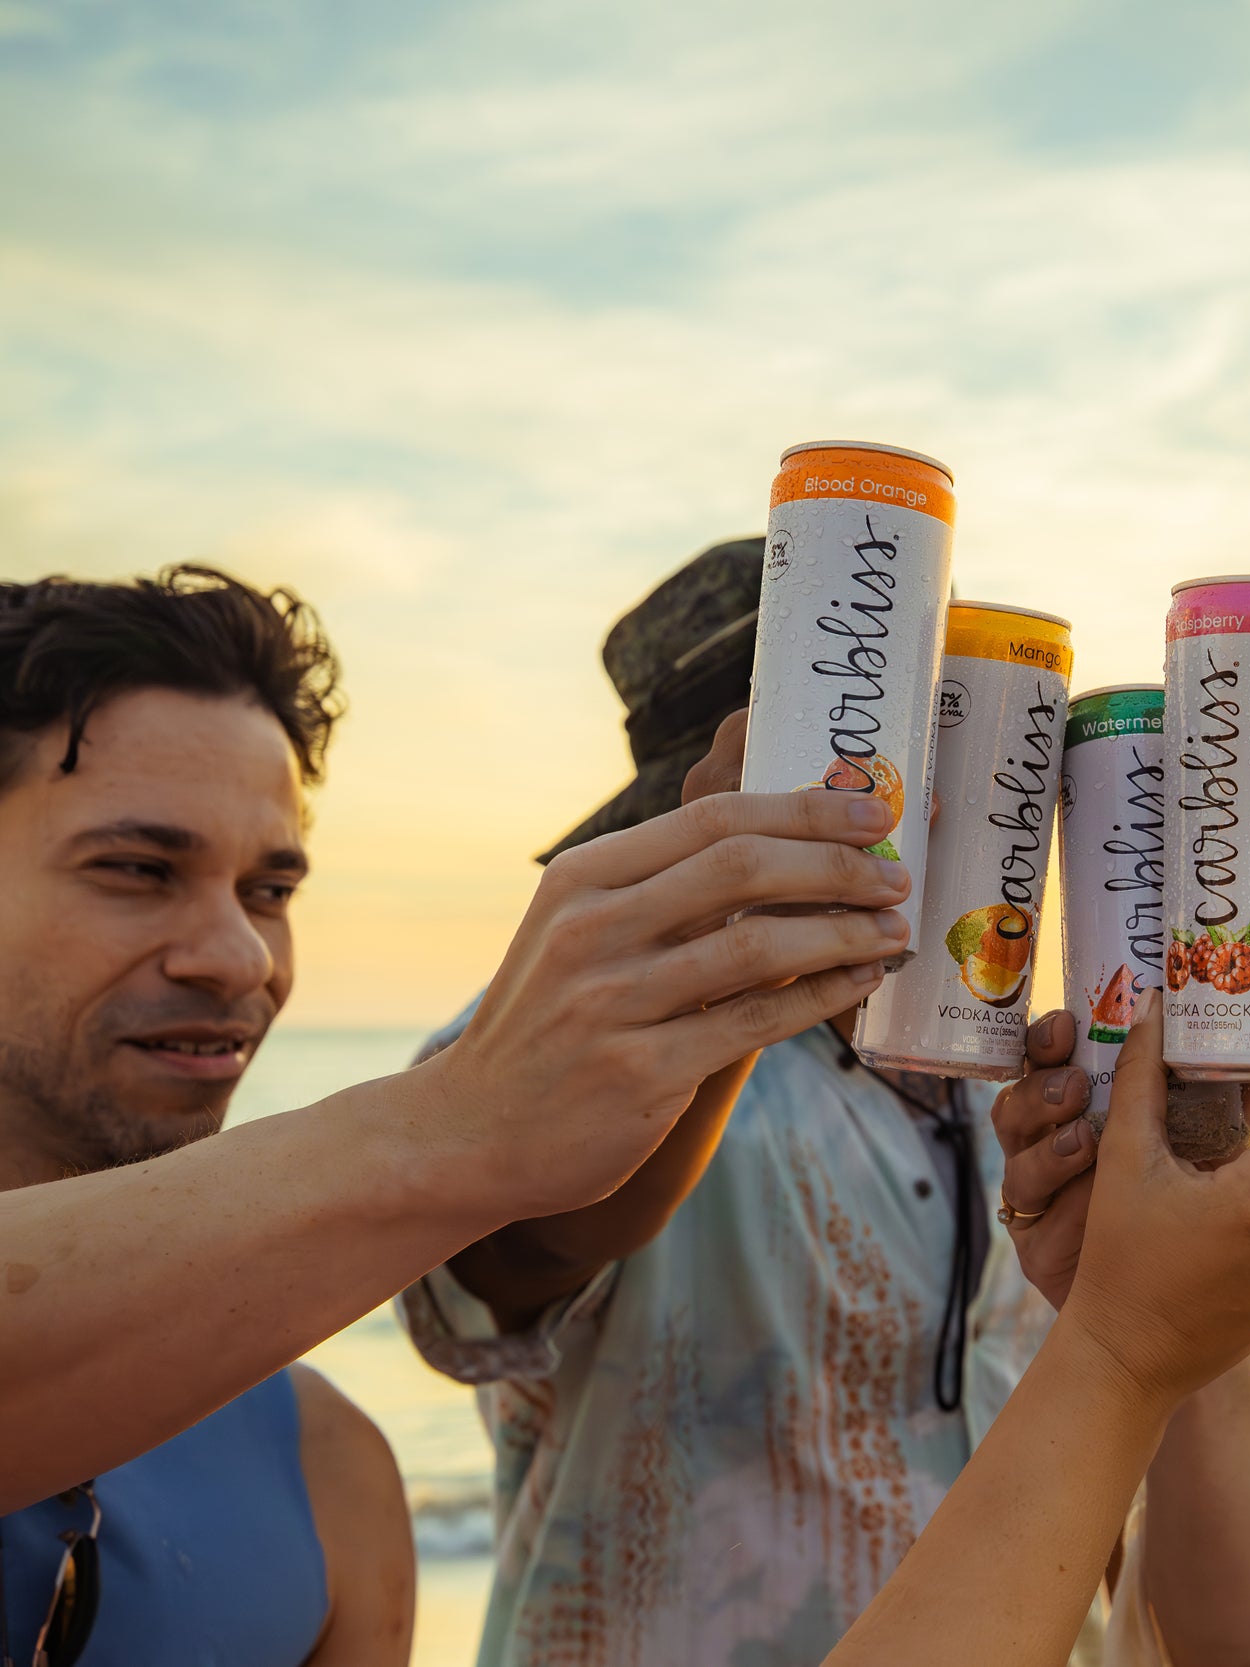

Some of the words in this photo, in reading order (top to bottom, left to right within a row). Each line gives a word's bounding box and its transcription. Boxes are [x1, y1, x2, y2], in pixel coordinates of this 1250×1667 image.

[804, 476, 855, 493] Blood
[859, 478, 928, 507] Orange
[1175, 614, 1245, 635] Raspberry
[1008, 641, 1061, 668] Mango
[1178, 647, 1240, 927] carbliss
[987, 680, 1058, 940] carbliss
[937, 1004, 991, 1023] VODKA
